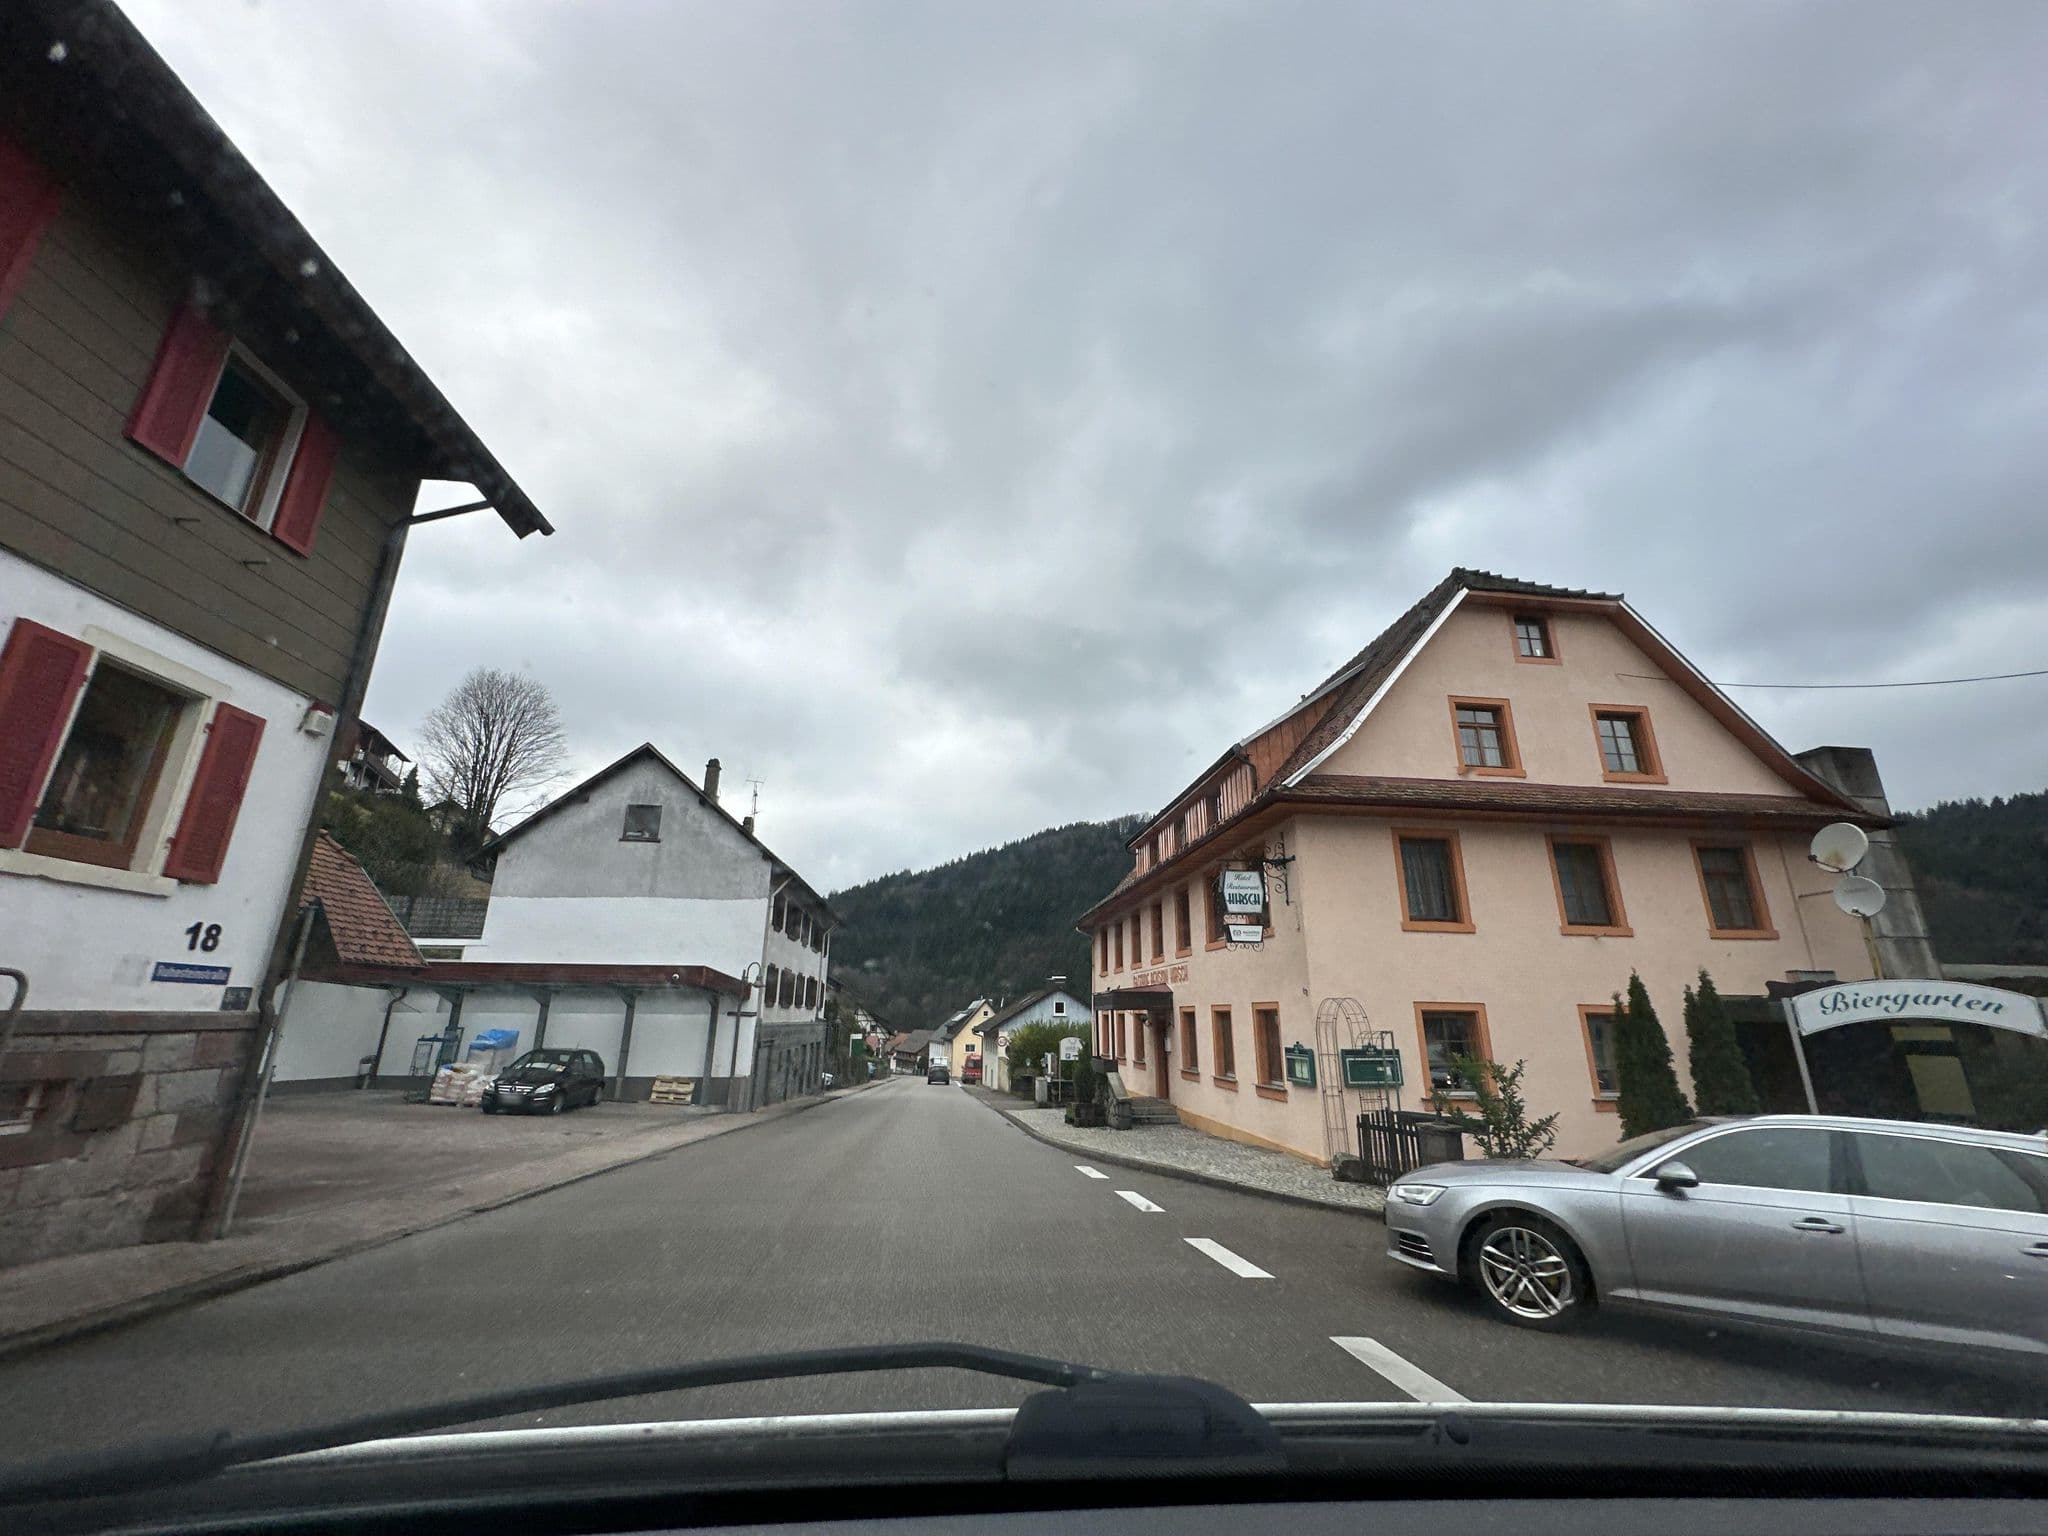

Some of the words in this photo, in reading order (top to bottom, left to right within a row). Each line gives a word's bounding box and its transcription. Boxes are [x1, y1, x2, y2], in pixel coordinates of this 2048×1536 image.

[1227, 892, 1261, 906] HIRSCH
[185, 921, 222, 952] 18
[1819, 991, 2004, 1015] Biergarten
